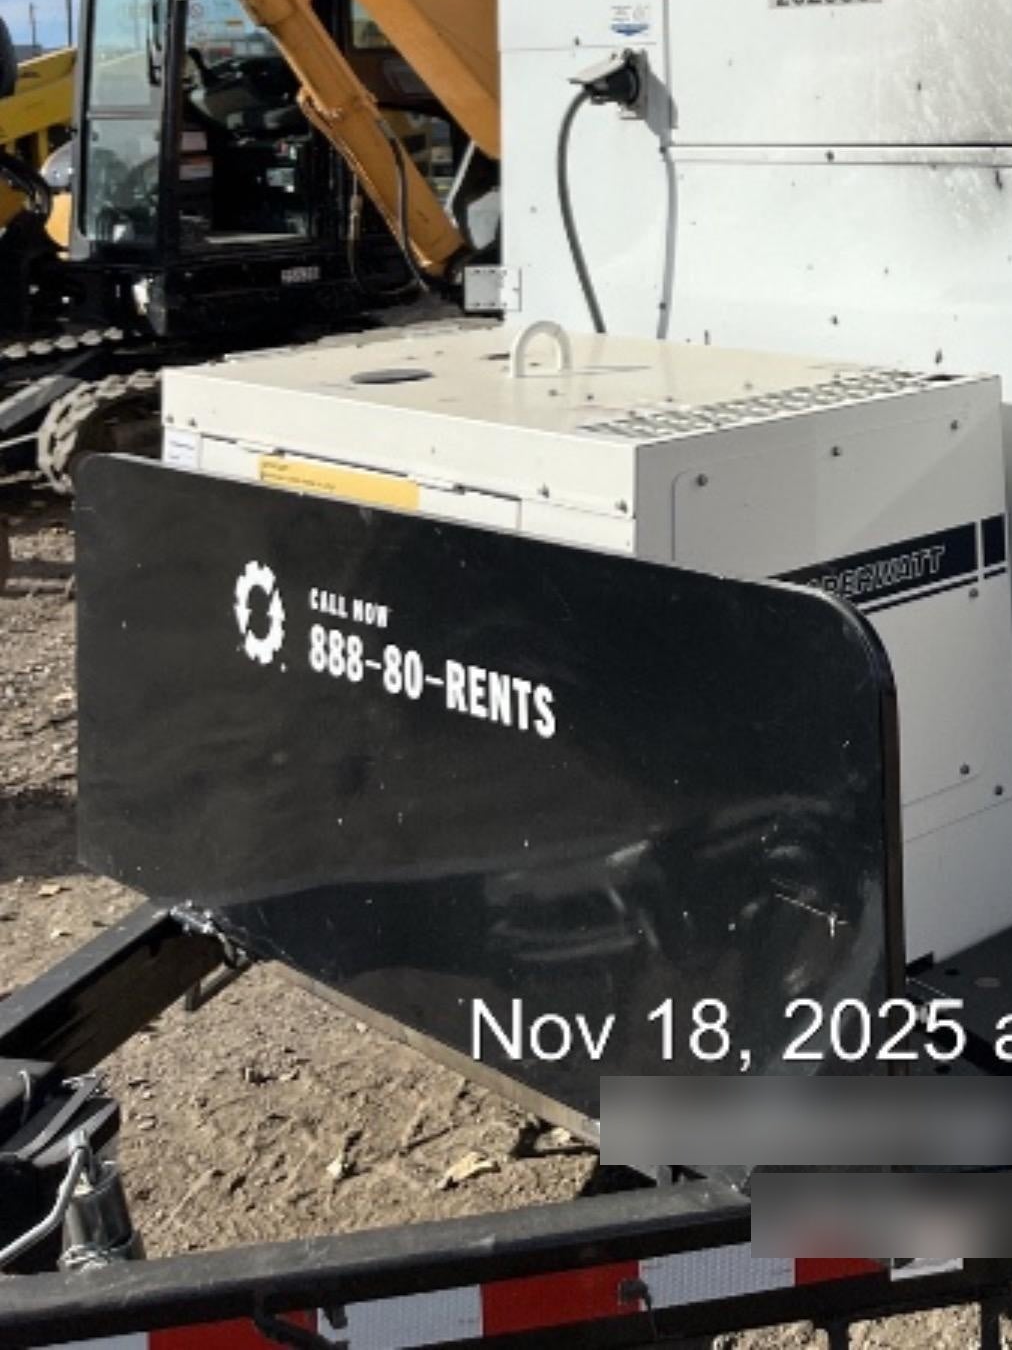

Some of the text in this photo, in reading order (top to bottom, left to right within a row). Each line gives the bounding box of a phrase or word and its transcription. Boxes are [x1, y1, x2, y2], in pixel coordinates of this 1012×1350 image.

[309, 587, 390, 628] CALL NOW
[308, 622, 556, 740] 888-80-RENTS
